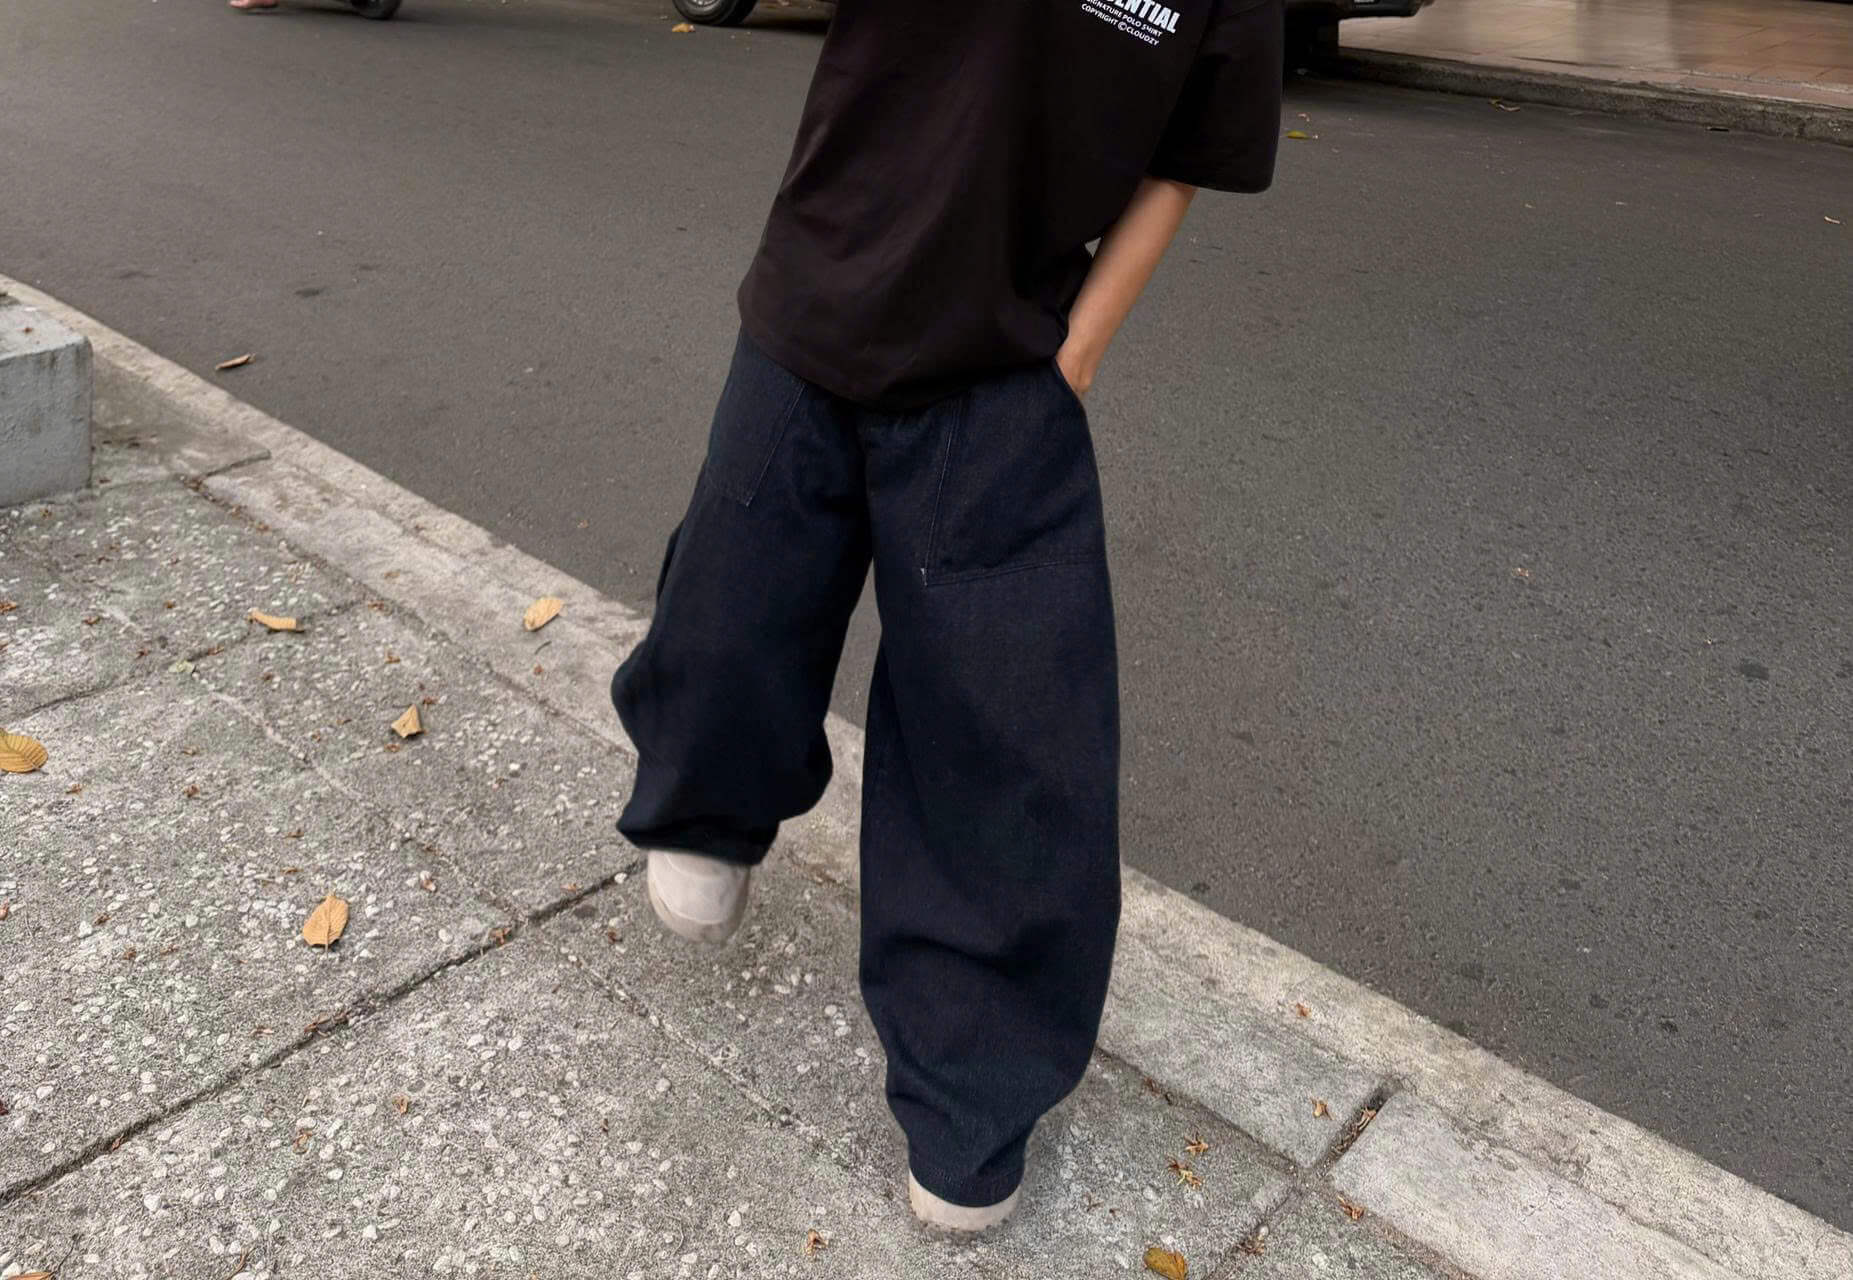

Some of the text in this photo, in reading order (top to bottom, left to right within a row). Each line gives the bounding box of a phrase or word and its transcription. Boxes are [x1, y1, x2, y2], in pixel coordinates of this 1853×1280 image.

[1081, 3, 1119, 25] COPYRIGHT
[1122, 14, 1142, 27] POLO
[1141, 23, 1163, 37] SHIRT
